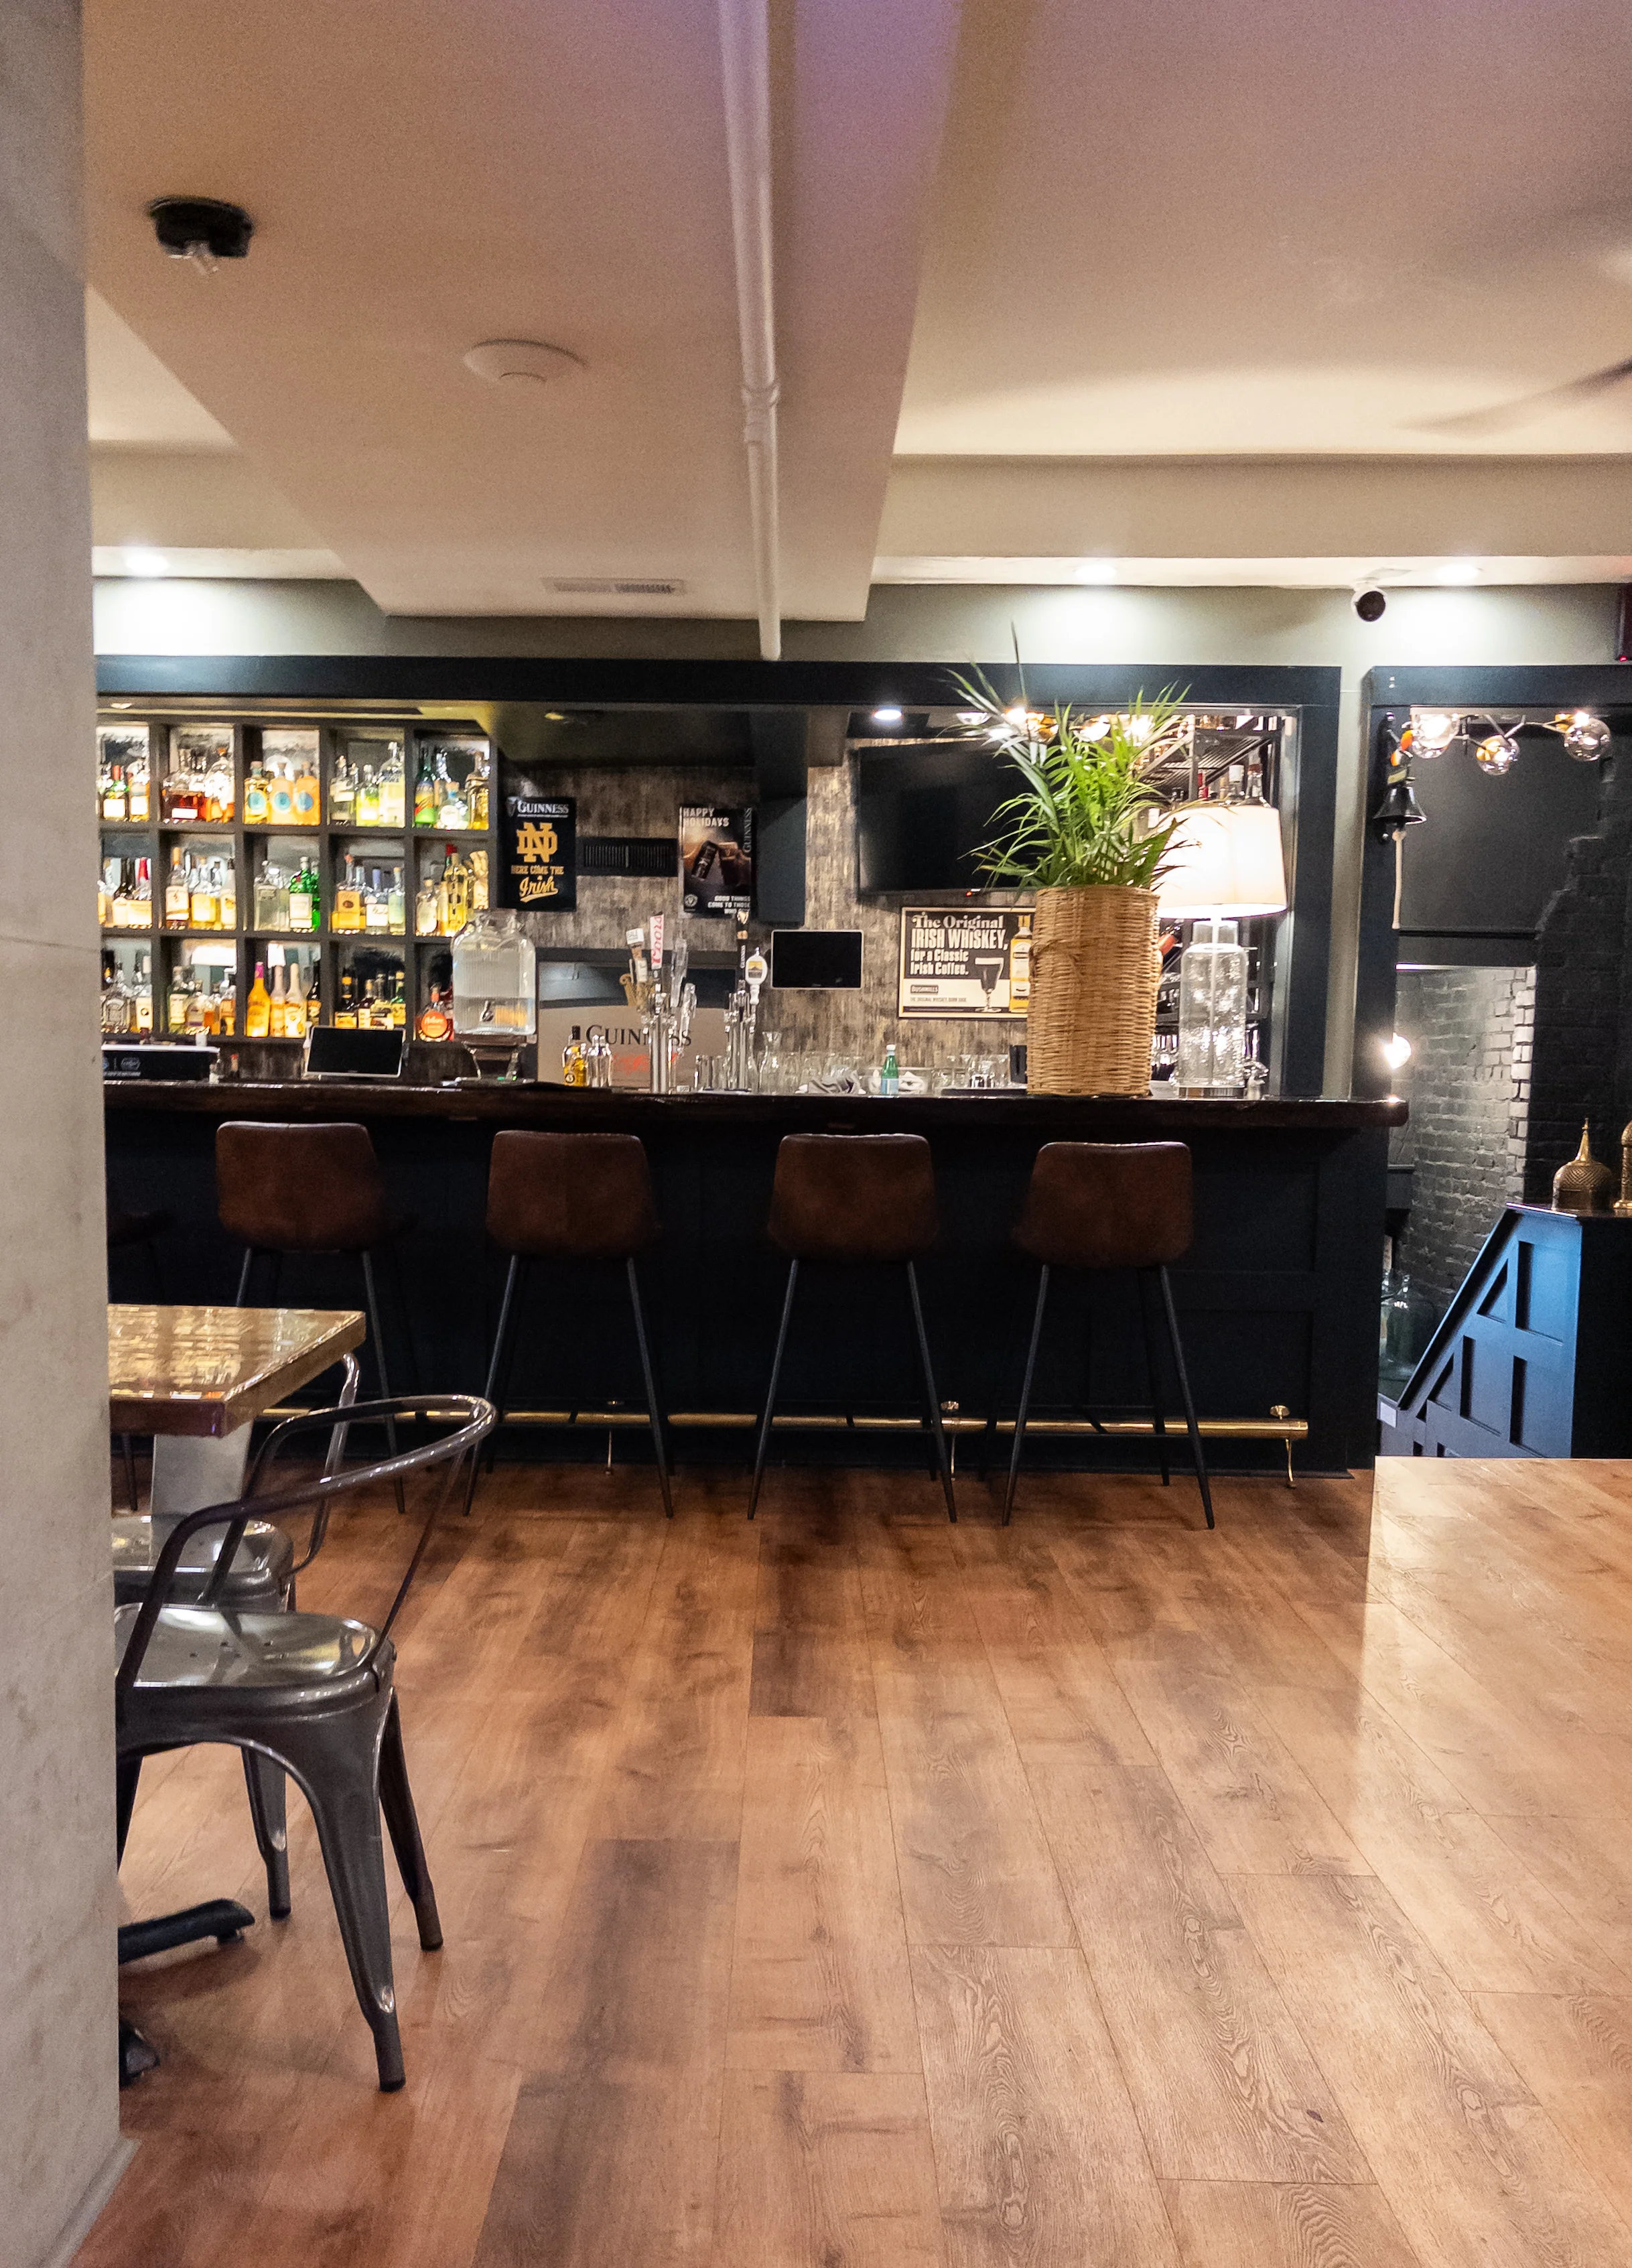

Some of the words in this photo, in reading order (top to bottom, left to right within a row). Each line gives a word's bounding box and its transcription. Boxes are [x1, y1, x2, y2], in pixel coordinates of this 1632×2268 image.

[517, 800, 569, 814] GUINNESS
[683, 807, 715, 817] HAPPY
[683, 817, 730, 827] HOLIDAYS
[743, 807, 752, 853] GUINNESS
[511, 866, 529, 874] HERE
[530, 866, 549, 875] COME
[550, 866, 565, 875] THE
[912, 912, 941, 929] The
[943, 915, 1004, 932] Original
[911, 928, 945, 949] IRISH
[948, 929, 1008, 950] WHISKEY,
[911, 949, 926, 961] for
[927, 950, 933, 961] a
[934, 949, 969, 962] Classic
[910, 961, 934, 974] Irish
[935, 962, 969, 975] Coffee.
